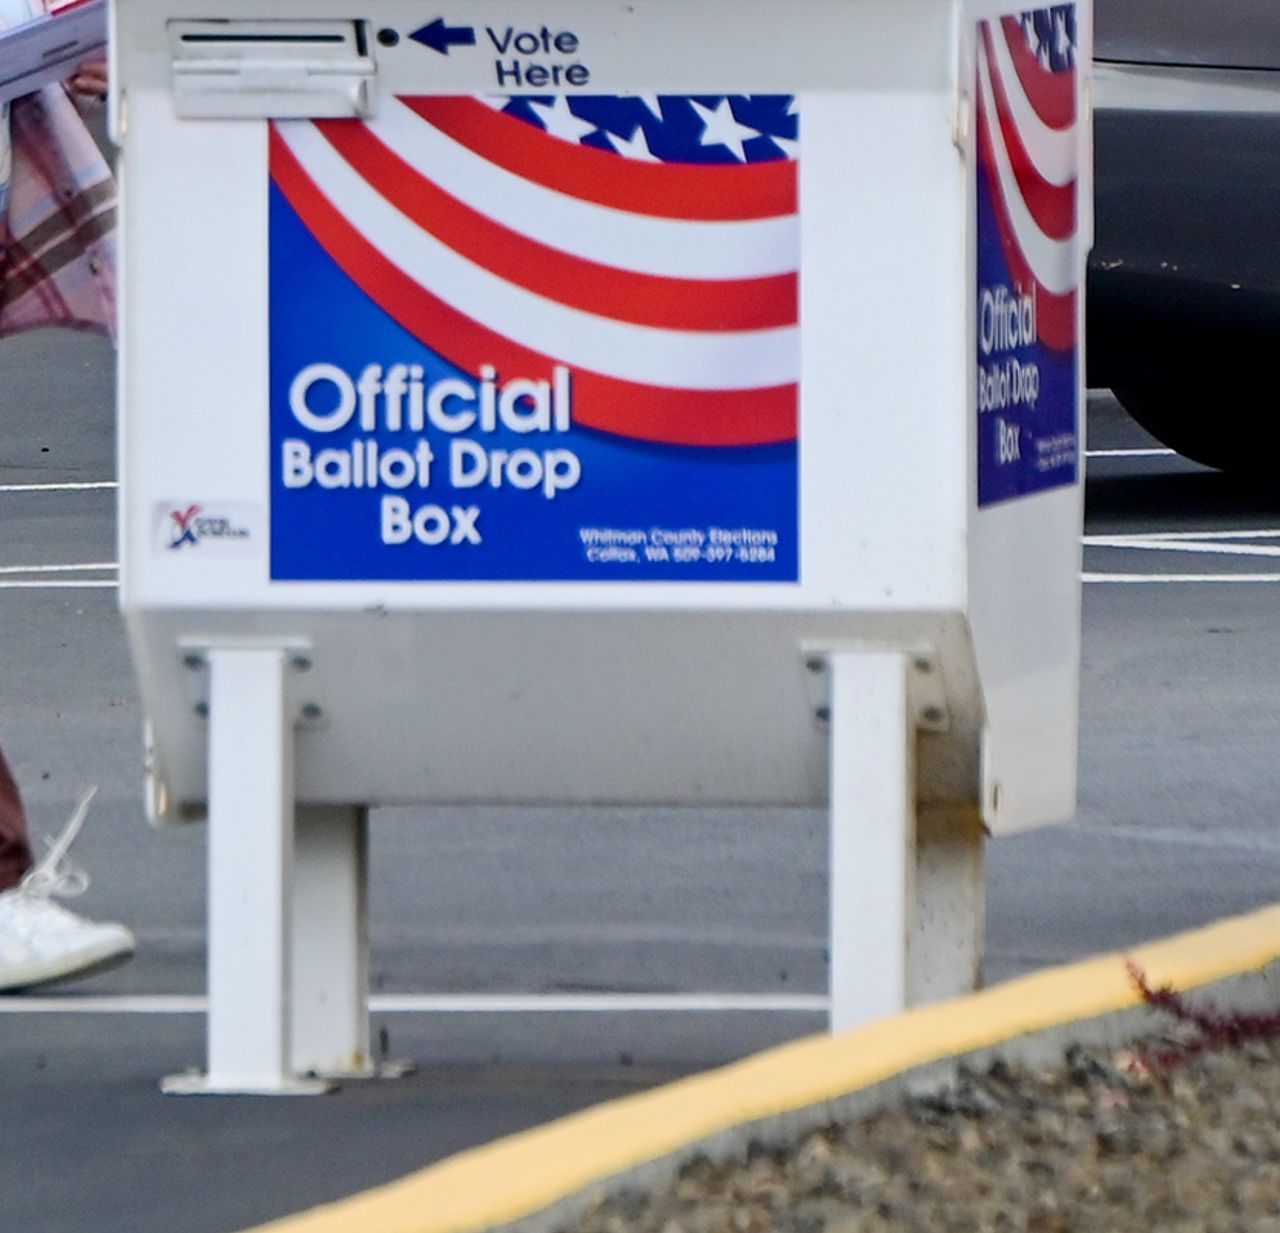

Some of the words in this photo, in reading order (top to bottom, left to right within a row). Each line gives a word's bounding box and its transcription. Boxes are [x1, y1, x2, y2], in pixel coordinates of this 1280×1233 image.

[485, 26, 579, 55] Vote
[495, 60, 590, 87] Here
[981, 281, 1037, 354] Official
[288, 362, 572, 435] Official
[979, 364, 1011, 413] Ballot
[1013, 359, 1040, 410] Drop
[999, 418, 1021, 464] Box
[280, 438, 435, 490] Ballot
[449, 438, 582, 499] Drop
[380, 494, 483, 546] Box
[650, 528, 706, 546] County
[708, 528, 778, 545] Elections
[644, 546, 669, 562] WA
